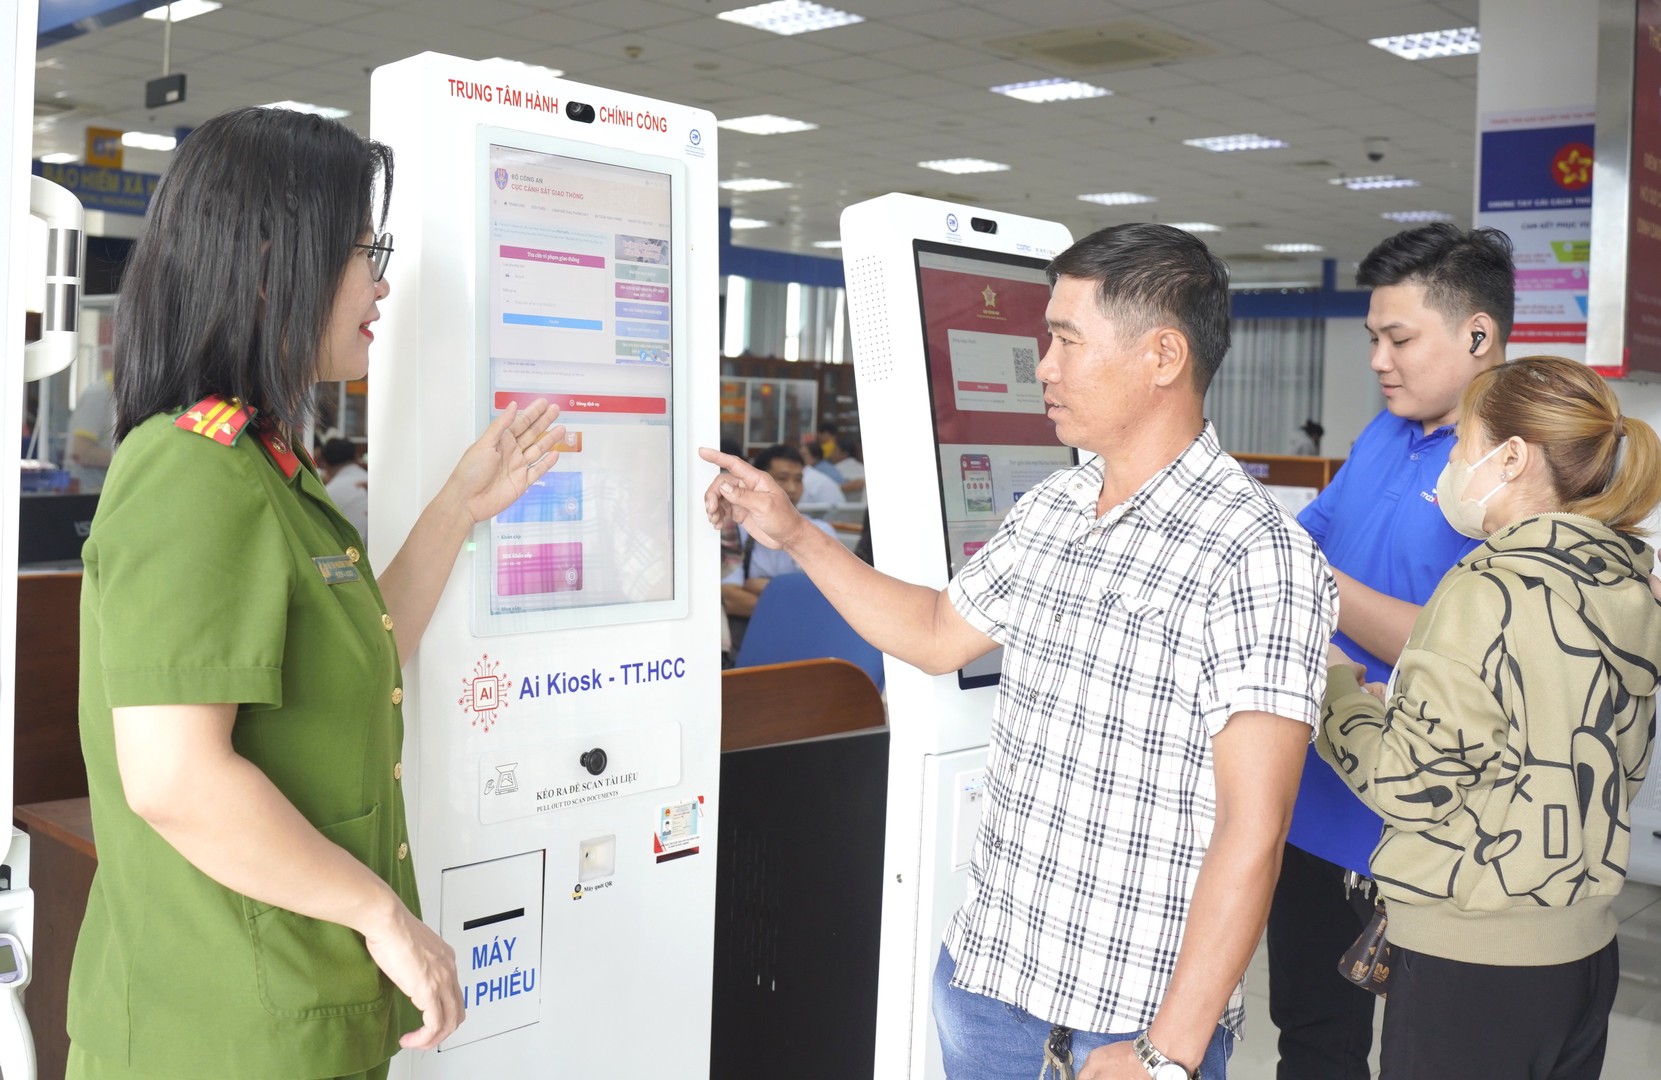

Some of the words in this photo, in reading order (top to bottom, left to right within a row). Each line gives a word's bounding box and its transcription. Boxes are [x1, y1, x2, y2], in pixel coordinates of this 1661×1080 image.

[448, 79, 493, 102] TRUNG
[496, 85, 522, 108] TÂM
[525, 90, 559, 114] HÀNH
[599, 105, 634, 128] CHÍNH
[636, 112, 668, 133] CÔNG
[511, 173, 519, 181] BỘ
[519, 174, 535, 183] CÔNG
[511, 183, 523, 191] CỤC
[524, 185, 539, 193] CẢNH
[540, 187, 550, 195] SÁT
[551, 189, 565, 197] GIAO
[566, 191, 584, 200] THÔNG
[519, 675, 540, 700] Ai
[546, 668, 603, 696] Kiosk
[620, 657, 686, 686] TT.HCC
[479, 686, 493, 701] AI
[536, 787, 555, 801] KÉO
[556, 787, 568, 797] RA
[582, 779, 604, 792] SCAN
[605, 774, 619, 786] TÀI
[620, 772, 639, 784] LIỆU
[536, 804, 551, 813] PULL
[551, 801, 563, 810] OUT
[572, 797, 586, 806] SCAN
[586, 790, 619, 802] DOCUMENTS
[604, 880, 613, 888] QR
[472, 935, 518, 971] MÁY
[475, 966, 536, 1007] PHIẾU
